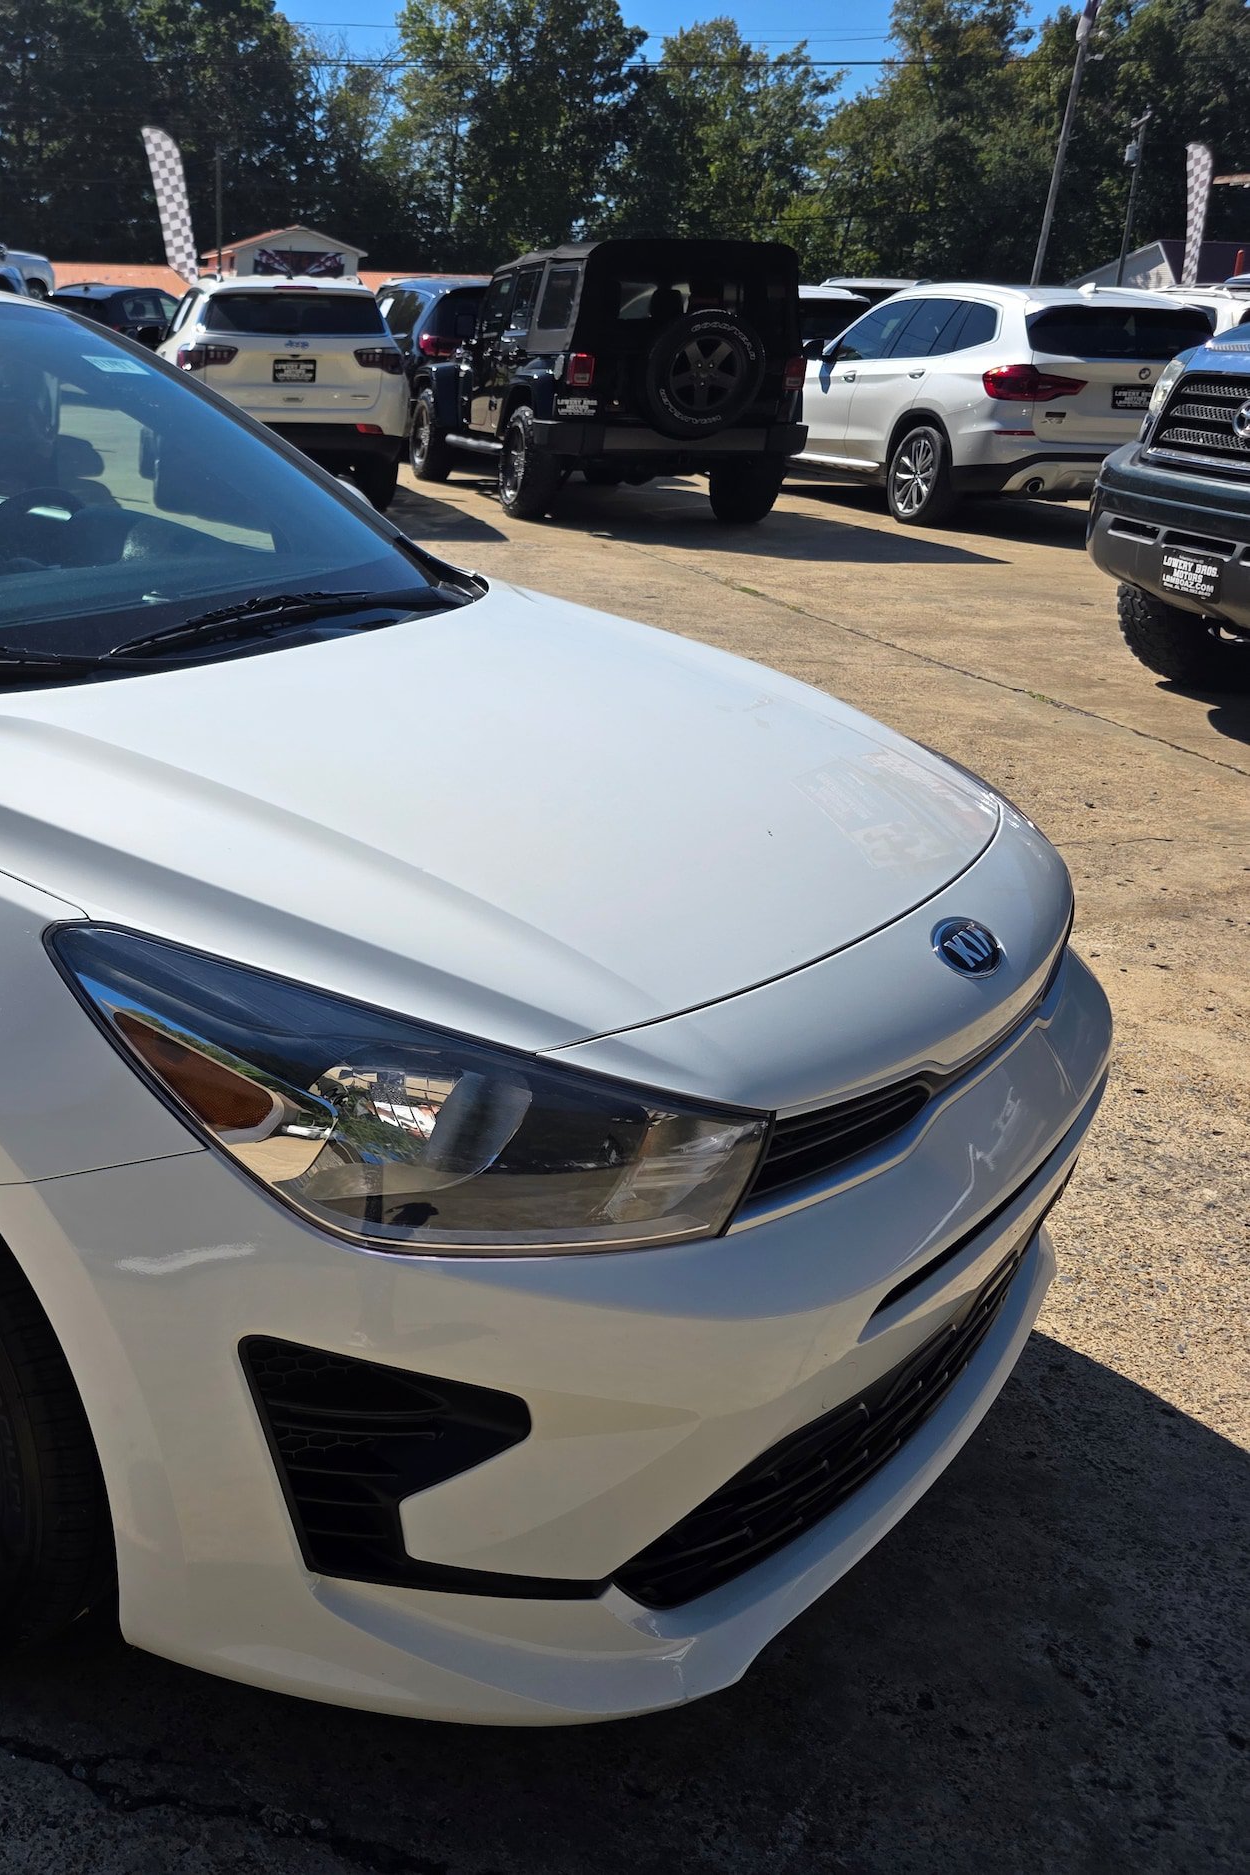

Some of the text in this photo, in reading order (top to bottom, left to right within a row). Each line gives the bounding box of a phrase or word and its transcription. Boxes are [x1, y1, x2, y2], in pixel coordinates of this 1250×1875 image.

[1162, 555, 1195, 572] LOWERY
[1195, 563, 1220, 578] BROS.
[1173, 568, 1204, 584] MOTORS
[943, 926, 993, 968] KIA
